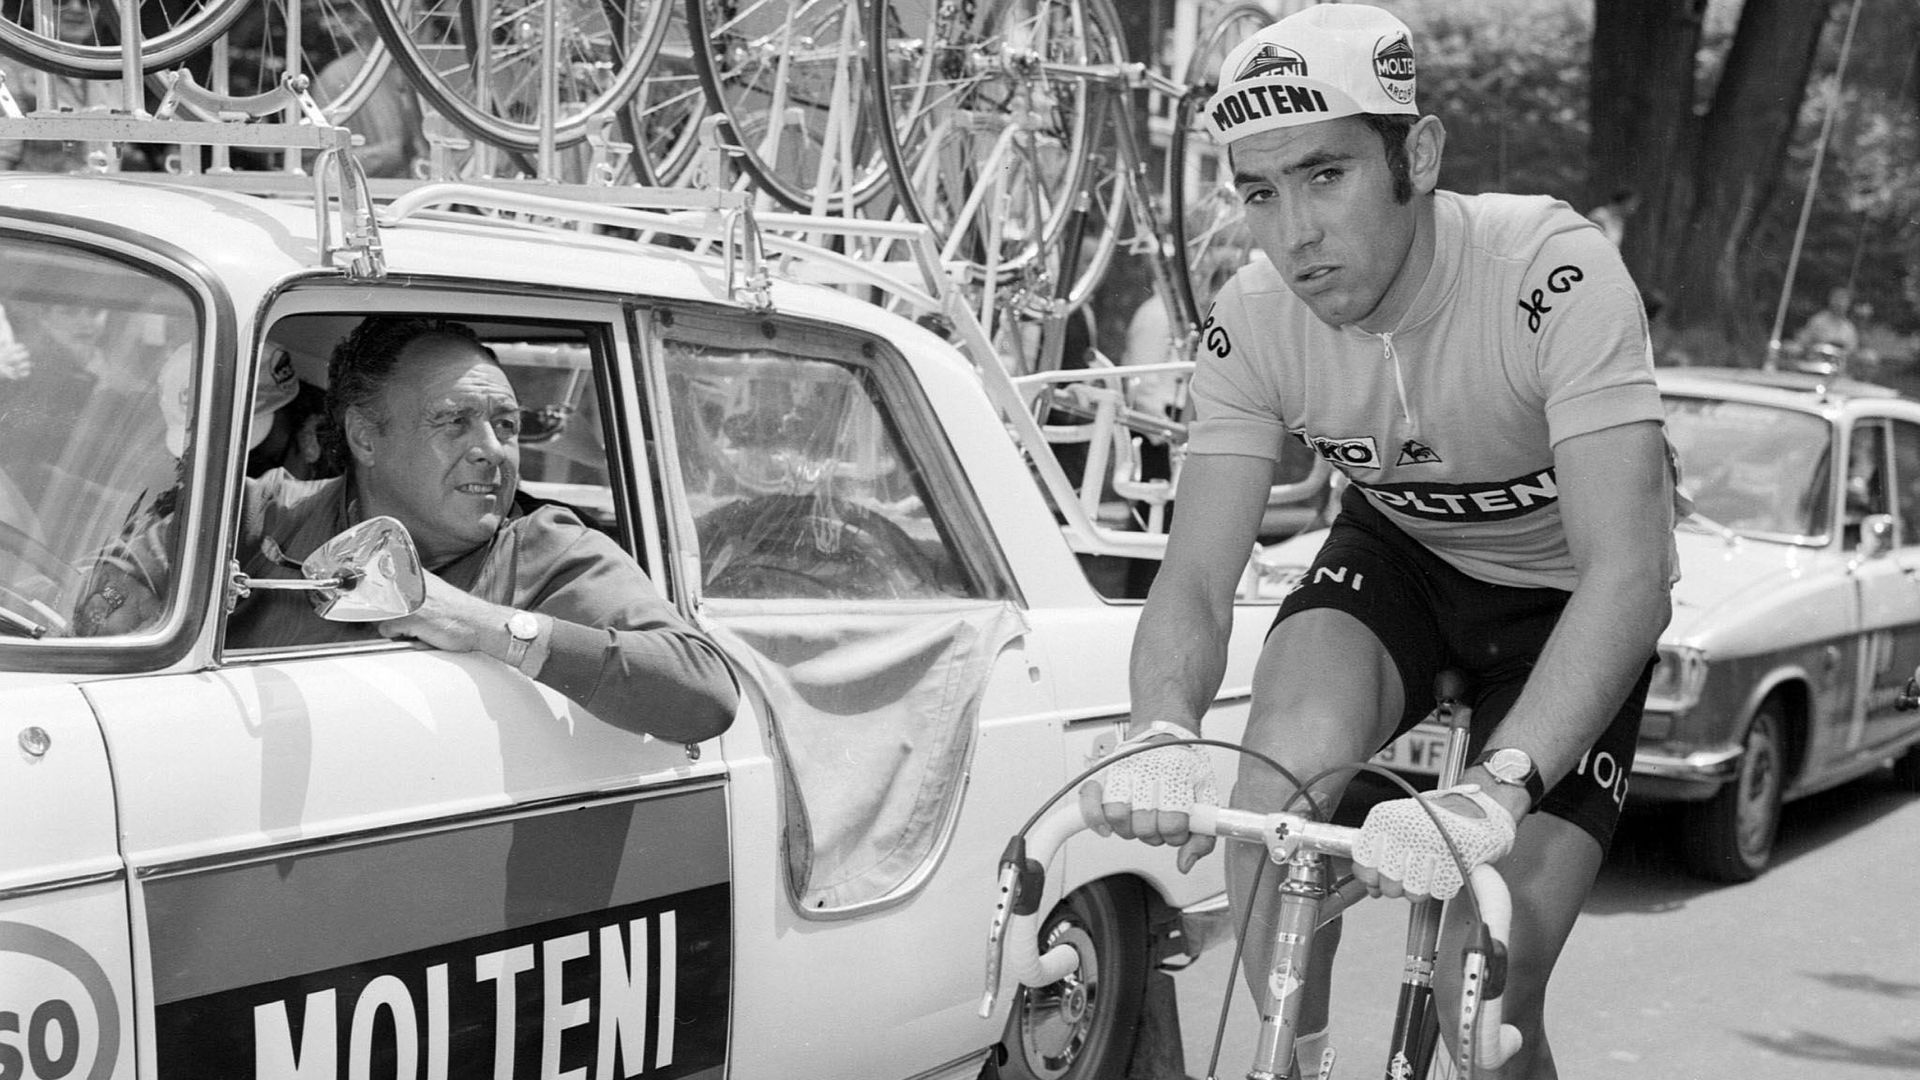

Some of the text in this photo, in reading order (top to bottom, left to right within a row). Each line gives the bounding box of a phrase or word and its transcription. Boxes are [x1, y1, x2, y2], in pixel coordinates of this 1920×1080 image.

[1376, 57, 1415, 76] MOLTE
[1212, 85, 1329, 131] MOLTENI
[1365, 468, 1558, 514] OLTEN
[254, 909, 677, 1080] MOLTENI
